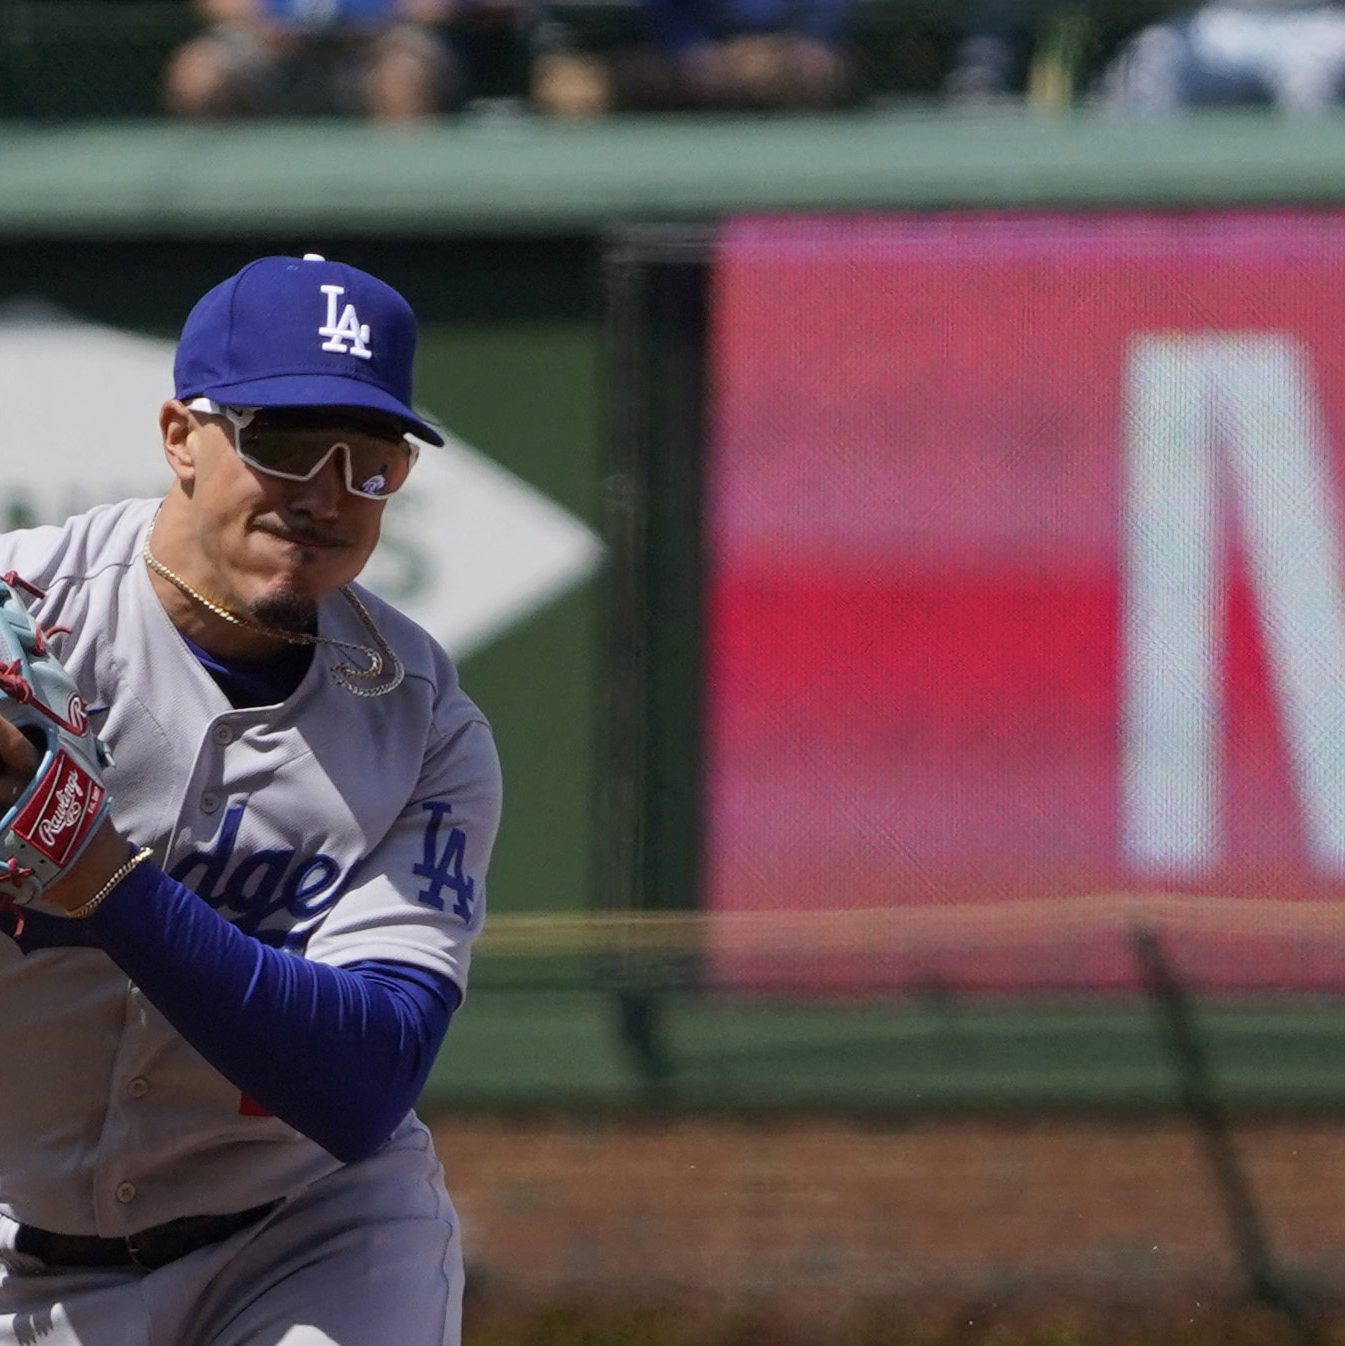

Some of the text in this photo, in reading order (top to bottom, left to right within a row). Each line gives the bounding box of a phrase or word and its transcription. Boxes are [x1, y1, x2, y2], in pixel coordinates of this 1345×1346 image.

[318, 284, 373, 360] LA
[38, 769, 84, 847] Rawlings
[412, 800, 476, 926] LA
